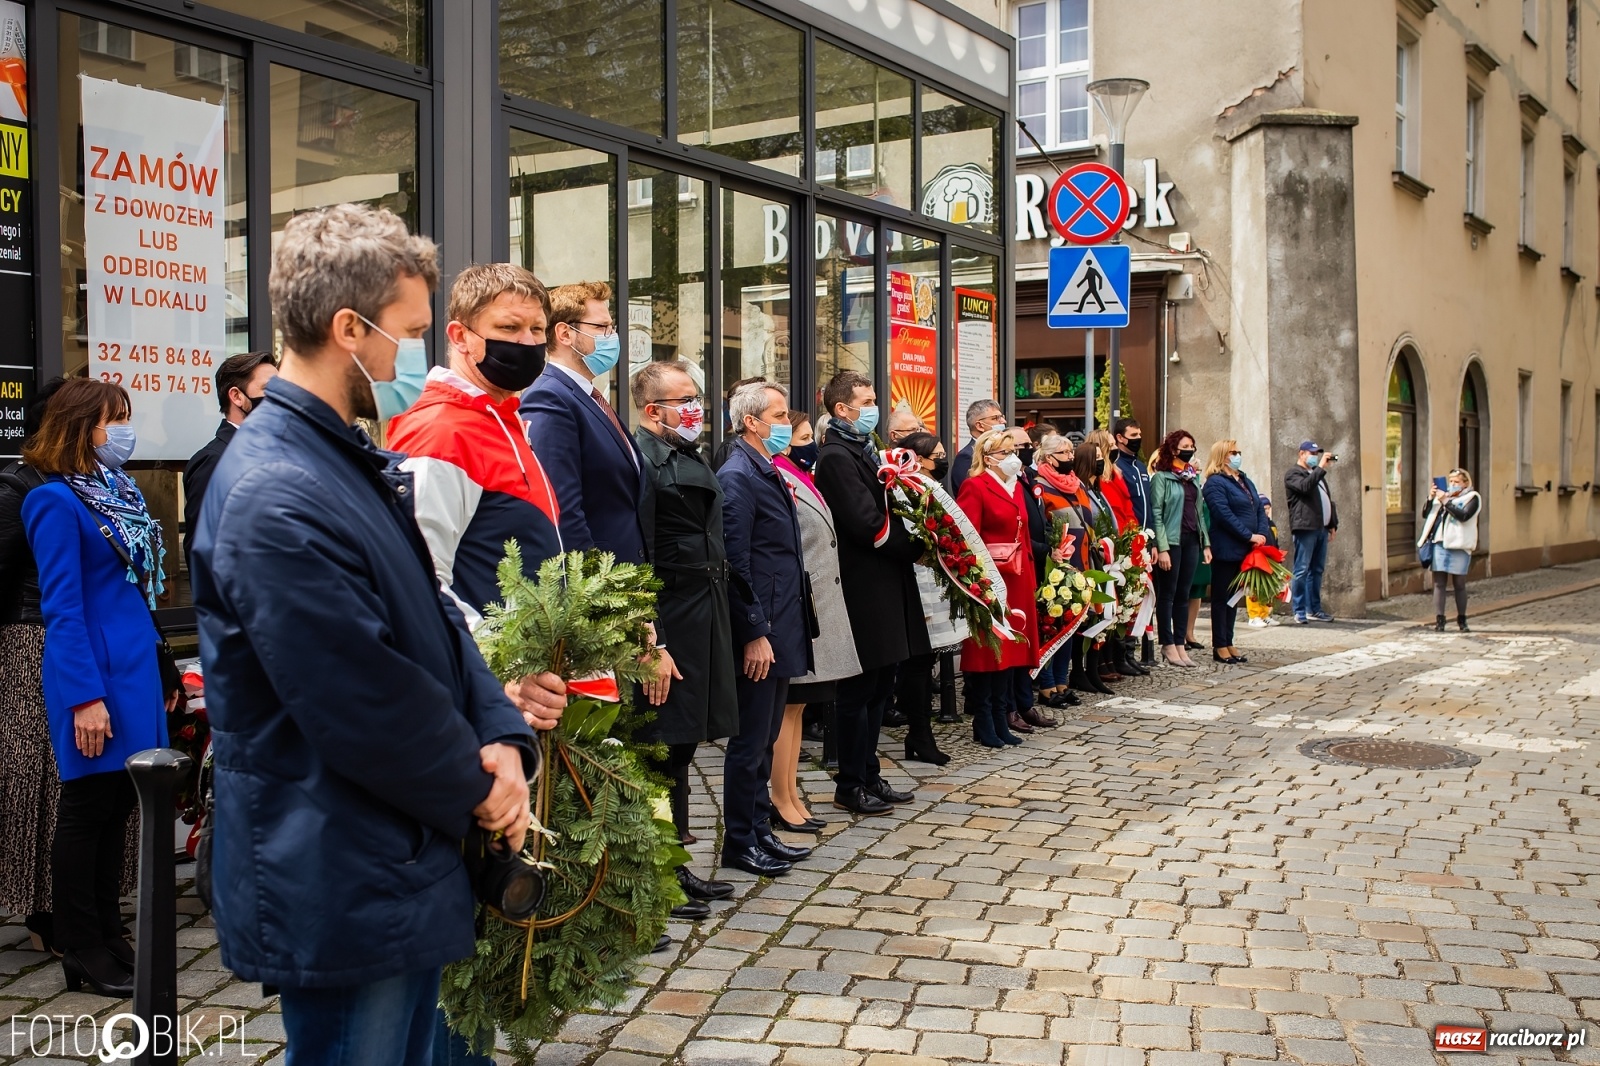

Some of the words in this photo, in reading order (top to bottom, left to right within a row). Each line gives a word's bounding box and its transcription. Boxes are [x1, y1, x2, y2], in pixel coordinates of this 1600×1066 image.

[90, 146, 218, 197] ZAMÓW
[94, 193, 106, 213] Z
[114, 196, 213, 228] DOWOZEM
[139, 229, 178, 251] LUB
[104, 255, 206, 284] ODBIOREM
[104, 284, 124, 304] W
[132, 287, 206, 312] LOKALU
[963, 296, 989, 314] LUNCH
[98, 343, 121, 361] 32
[129, 345, 158, 363] 415
[166, 347, 186, 366] 84
[191, 349, 212, 367] 84
[902, 352, 913, 362] DWA
[914, 354, 926, 363] PIWA
[900, 363, 913, 372] CENIE
[913, 365, 933, 374] JEDNEGO
[131, 374, 161, 392] 415
[167, 375, 186, 393] 74
[191, 376, 211, 394] 75
[5, 406, 24, 420] kcal
